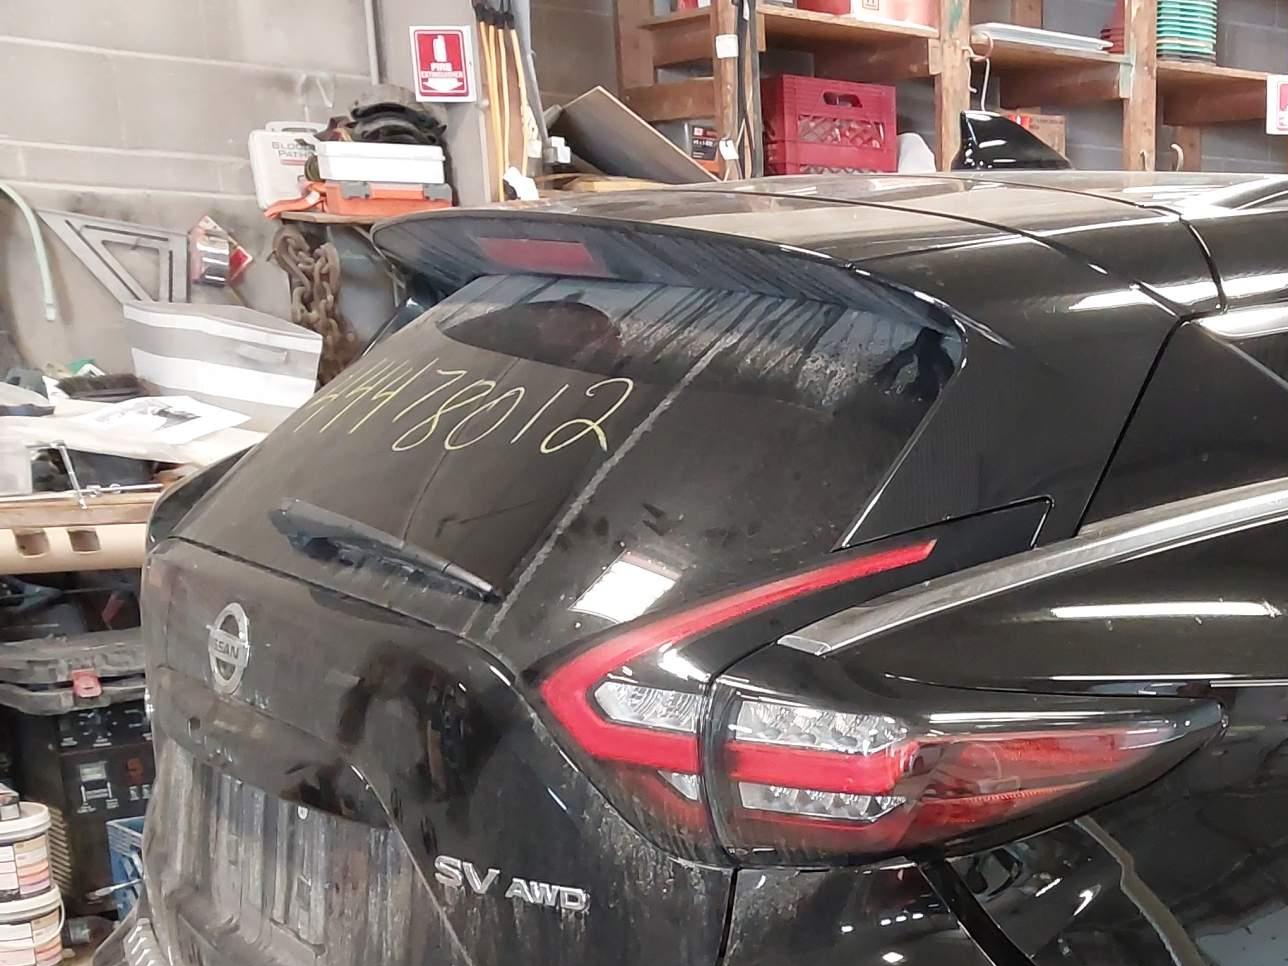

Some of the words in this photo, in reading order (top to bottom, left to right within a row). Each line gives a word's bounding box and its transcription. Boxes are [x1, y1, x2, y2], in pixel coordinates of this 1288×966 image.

[294, 358, 634, 453] 44478012
[434, 855, 500, 894] SV
[505, 877, 588, 911] AWD
